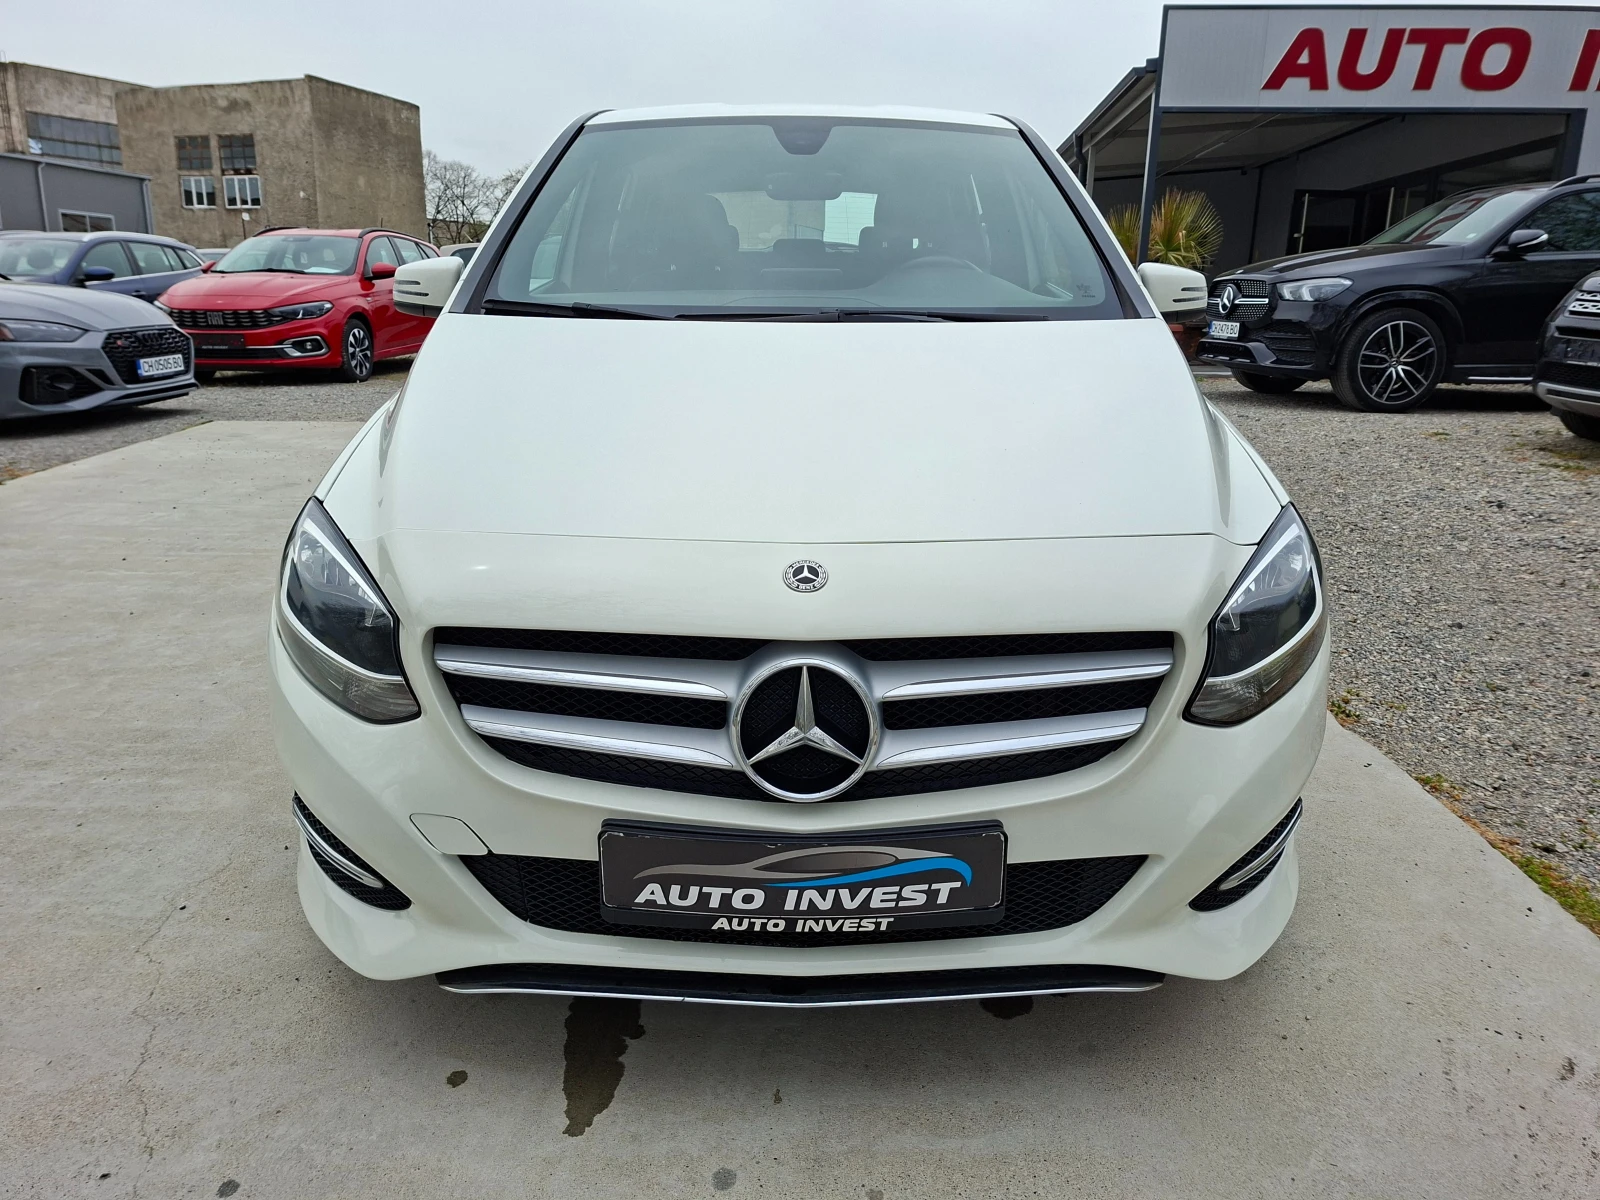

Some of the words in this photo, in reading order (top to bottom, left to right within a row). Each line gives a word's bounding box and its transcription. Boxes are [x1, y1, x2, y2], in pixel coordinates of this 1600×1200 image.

[1260, 27, 1532, 92] AUTO
[207, 312, 224, 325] FIAT
[634, 883, 765, 910] AUTO
[784, 881, 962, 911] INVEST
[711, 917, 785, 931] AUTO
[795, 917, 894, 932] INVEST
